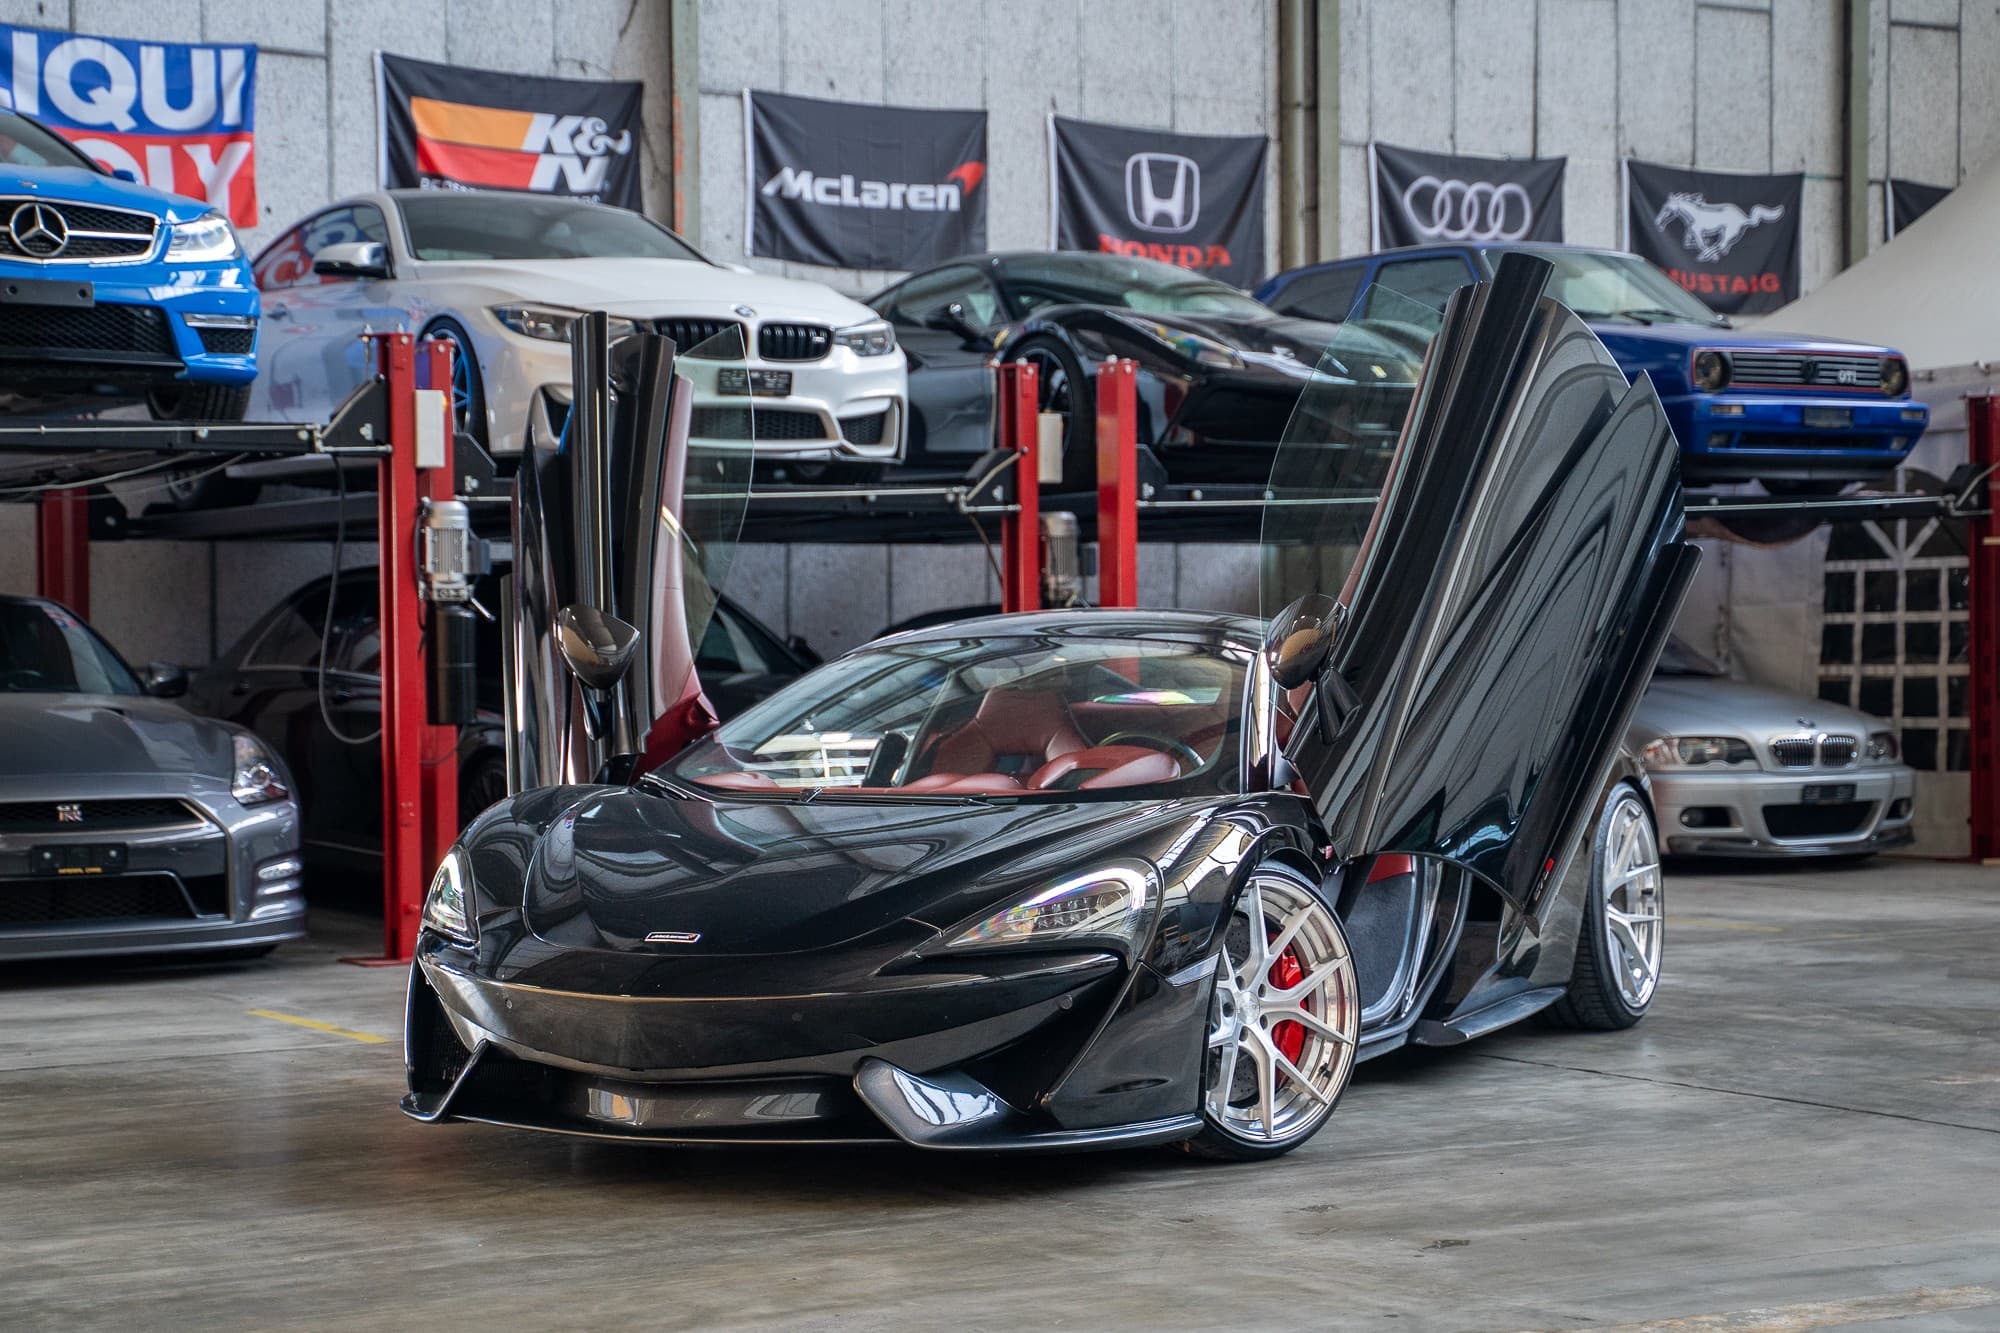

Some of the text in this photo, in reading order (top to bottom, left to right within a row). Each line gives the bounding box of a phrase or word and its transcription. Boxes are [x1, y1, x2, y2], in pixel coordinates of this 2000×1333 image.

[0, 30, 246, 132] IQUI
[761, 166, 961, 212] McLaren
[1098, 233, 1232, 268] HONDA
